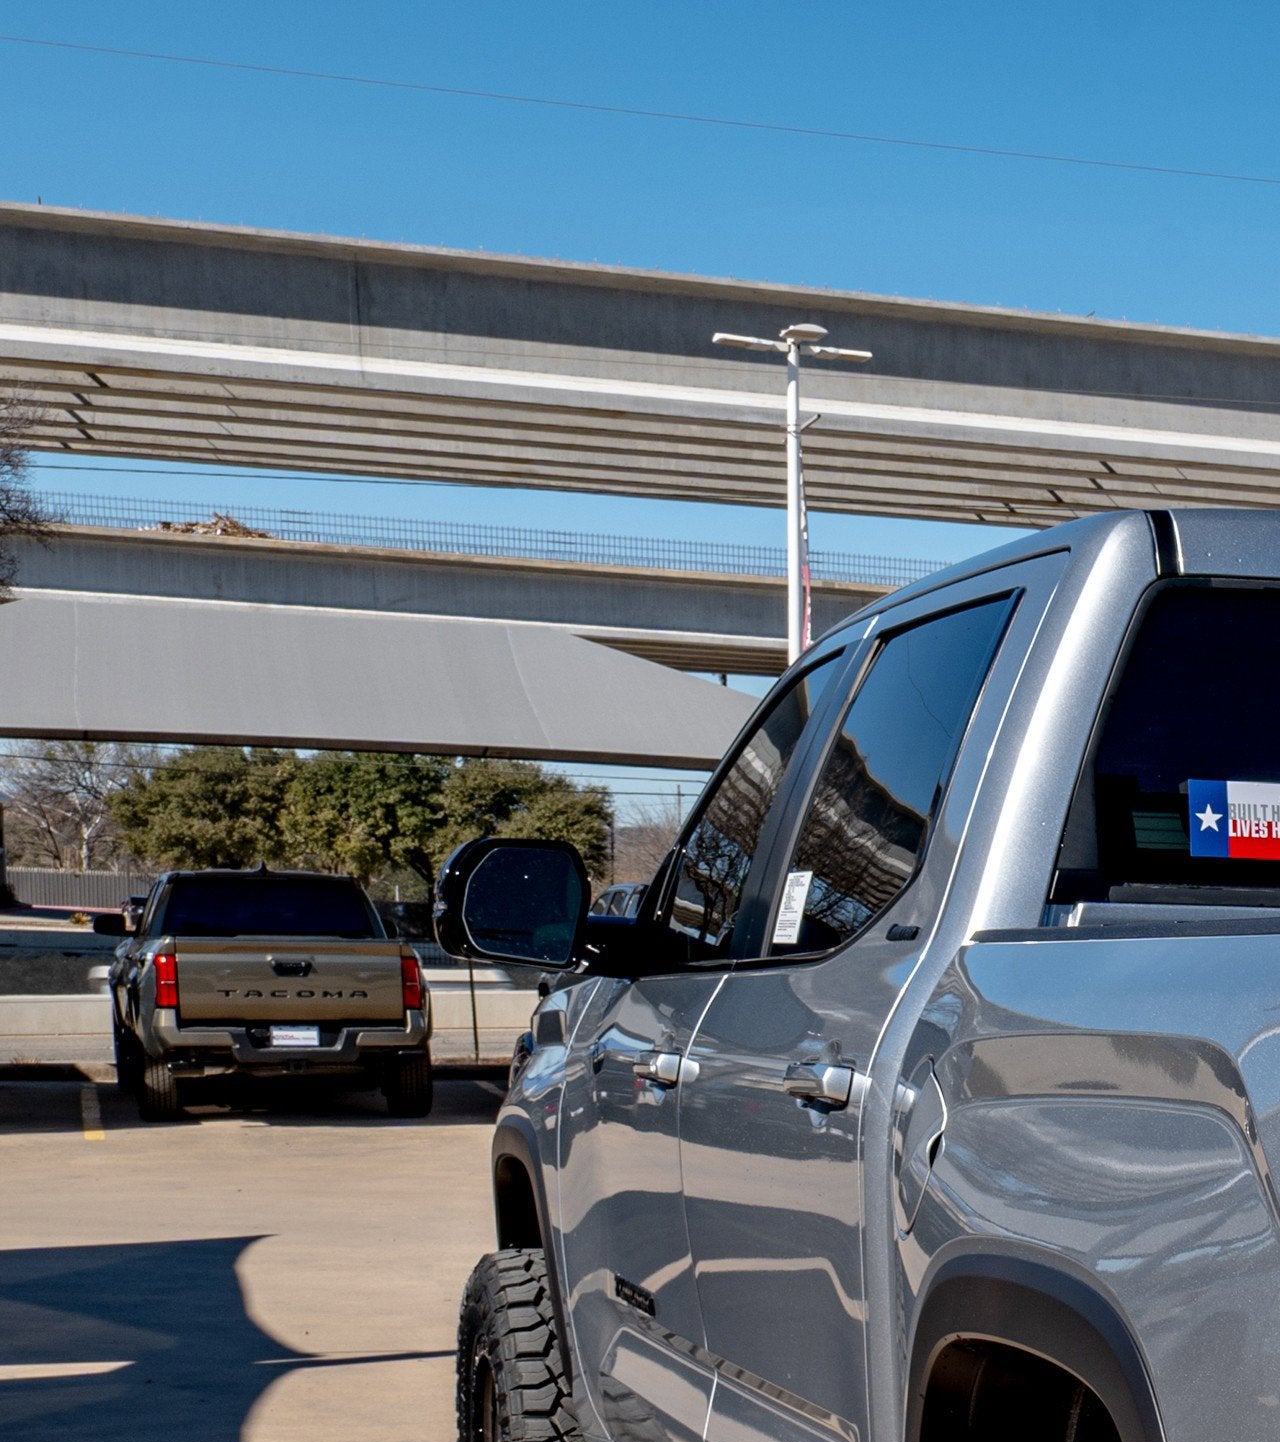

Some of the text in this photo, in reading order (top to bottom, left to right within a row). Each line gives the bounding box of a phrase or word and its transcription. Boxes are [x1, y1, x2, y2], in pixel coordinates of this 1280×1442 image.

[1228, 803, 1268, 822] BUILT
[1228, 819, 1268, 838] LIVES
[216, 989, 369, 999] TACOMA
